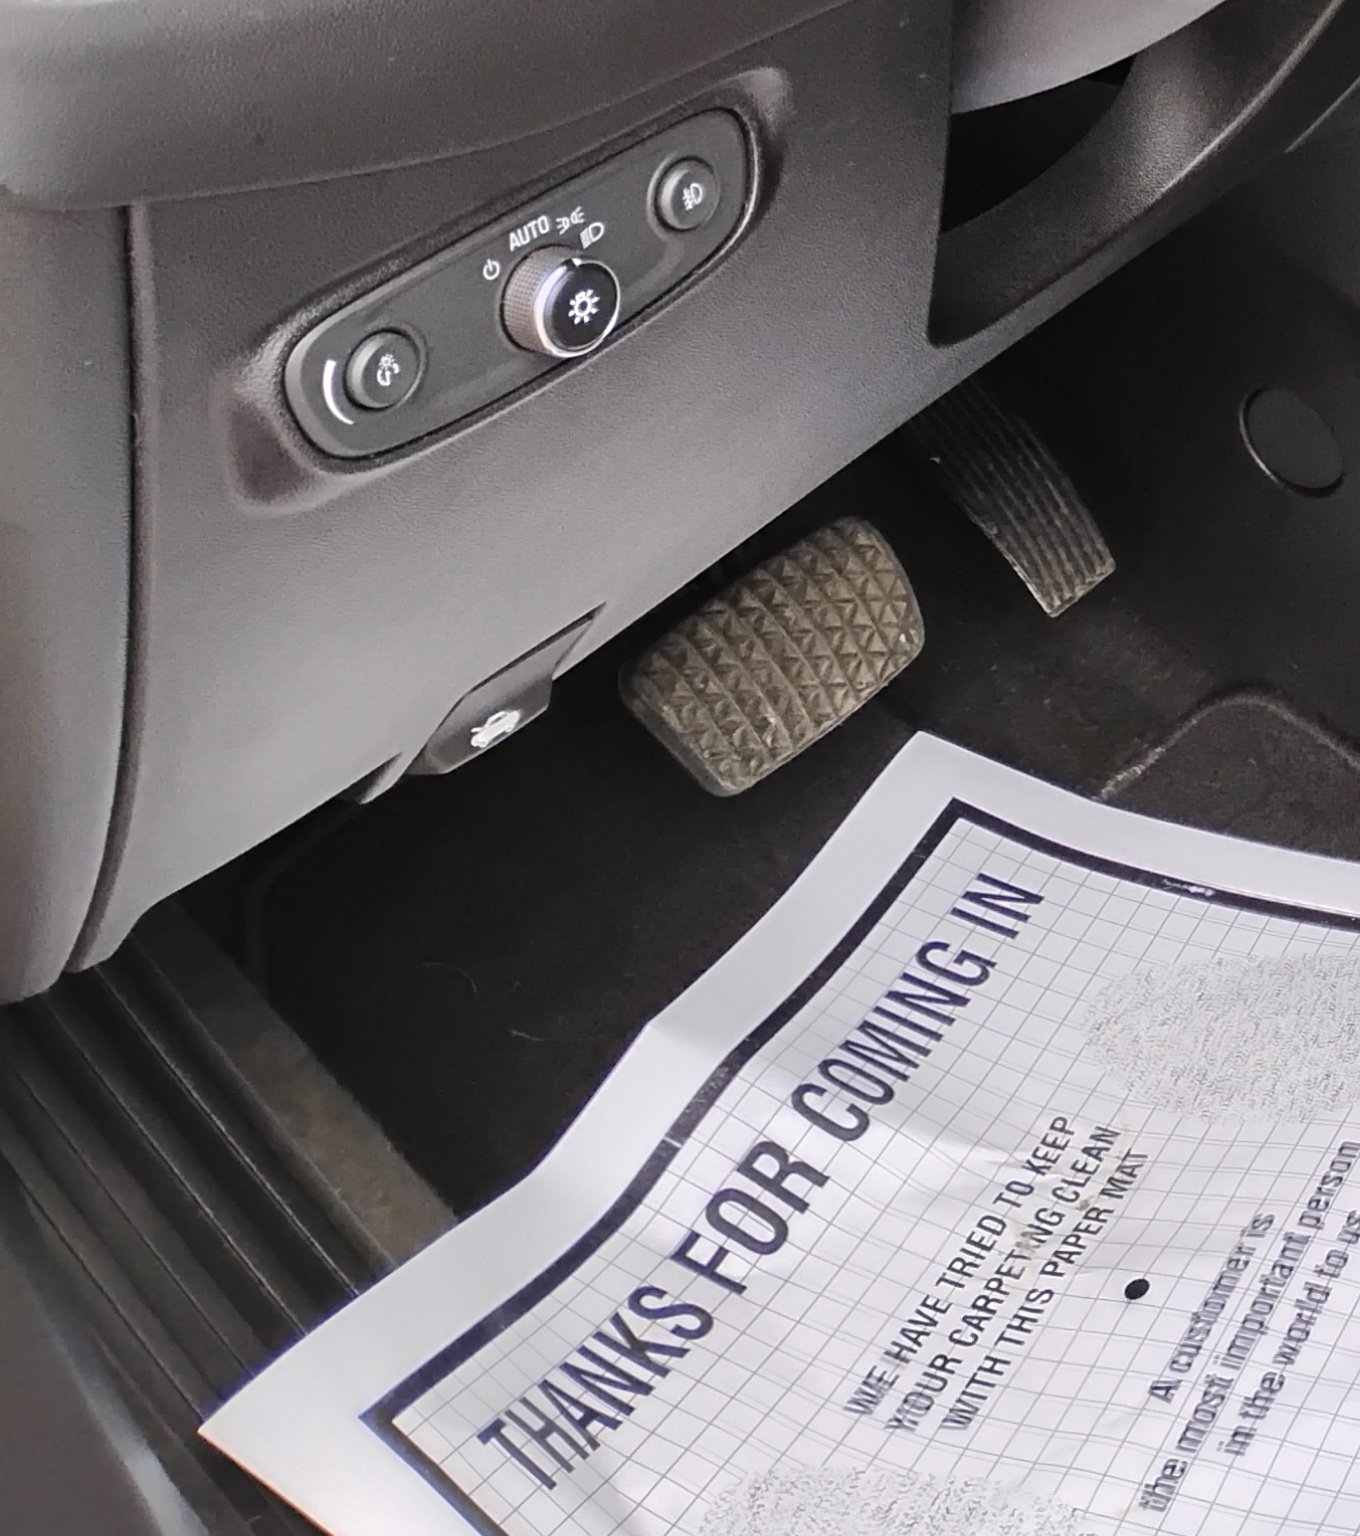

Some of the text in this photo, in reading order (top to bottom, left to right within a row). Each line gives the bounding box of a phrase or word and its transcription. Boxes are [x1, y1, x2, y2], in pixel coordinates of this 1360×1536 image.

[508, 215, 550, 252] AUTO
[476, 872, 1045, 1491] THANKS FOR COMING IN
[842, 1116, 1075, 1415] WE HAVE TRIED TO KEEP
[885, 1354, 963, 1432] YOUR
[1052, 1125, 1121, 1204] CLEAN
[939, 1147, 1149, 1431] WITH THIS PAPER MAT
[1147, 1213, 1276, 1404] A customer is
[1138, 1458, 1188, 1512] the
[1176, 1373, 1234, 1453] most
[1212, 1231, 1311, 1371] important
[1216, 1425, 1258, 1457] in
[1237, 1371, 1286, 1420] the
[1272, 1280, 1333, 1366] world
[1313, 1249, 1350, 1279] to
